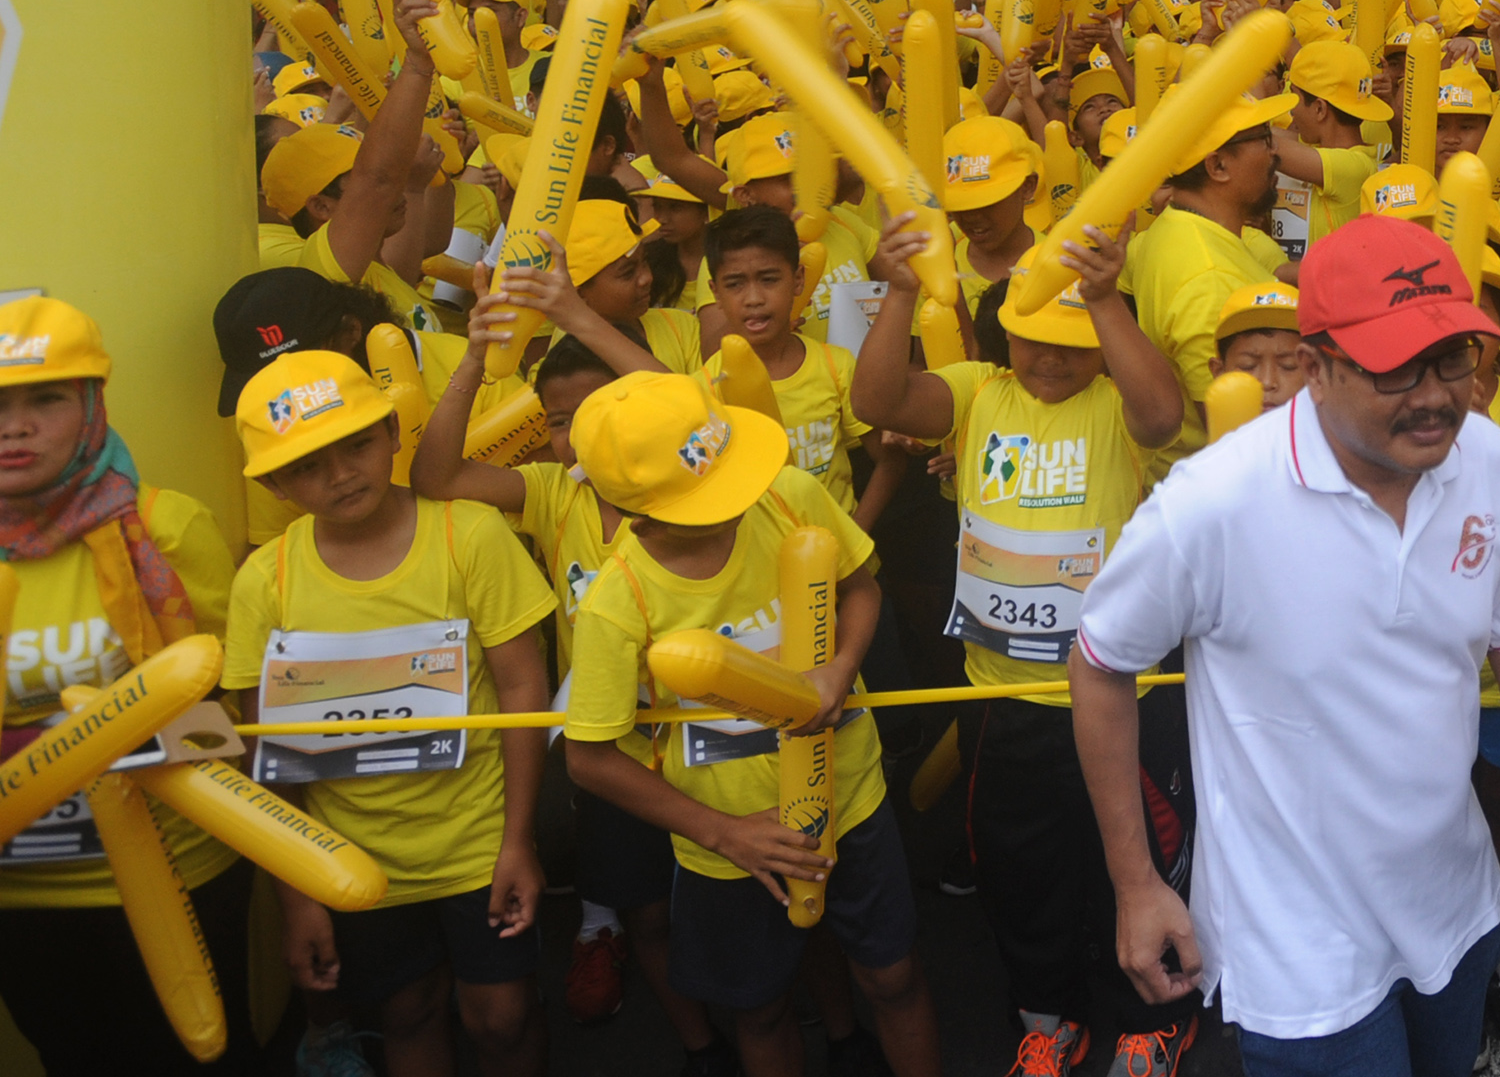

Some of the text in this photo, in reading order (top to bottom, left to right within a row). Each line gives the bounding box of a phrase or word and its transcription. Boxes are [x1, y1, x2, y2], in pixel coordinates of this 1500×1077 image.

[479, 30, 495, 73] Financial
[314, 30, 381, 108] Life Financial
[1402, 53, 1416, 151] Life Financial
[1452, 94, 1473, 104] LIFE
[535, 16, 609, 224] Sun Life Financial
[963, 165, 990, 176] LIFE
[964, 156, 990, 167] SUN
[1391, 184, 1415, 195] SUN
[1391, 193, 1416, 203] LIFE
[1292, 244, 1303, 254] 2K
[817, 260, 863, 302] SUN
[1278, 294, 1298, 306] SU
[293, 376, 337, 401] SUN
[299, 388, 342, 413] LIFE
[1024, 438, 1086, 470] SUN
[1021, 466, 1087, 496] LIFE
[1018, 494, 1086, 508] RESOLUTION WALK
[1071, 565, 1094, 575] LIFE
[1072, 558, 1094, 568] SUN
[735, 597, 781, 638] SU
[988, 593, 1058, 629] 2343
[427, 660, 456, 671] LIFE
[428, 652, 455, 662] SUN
[806, 580, 829, 787] Sun nancial
[27, 672, 148, 777] Financial
[430, 740, 454, 755] 2K
[211, 764, 350, 854] Life Financial
